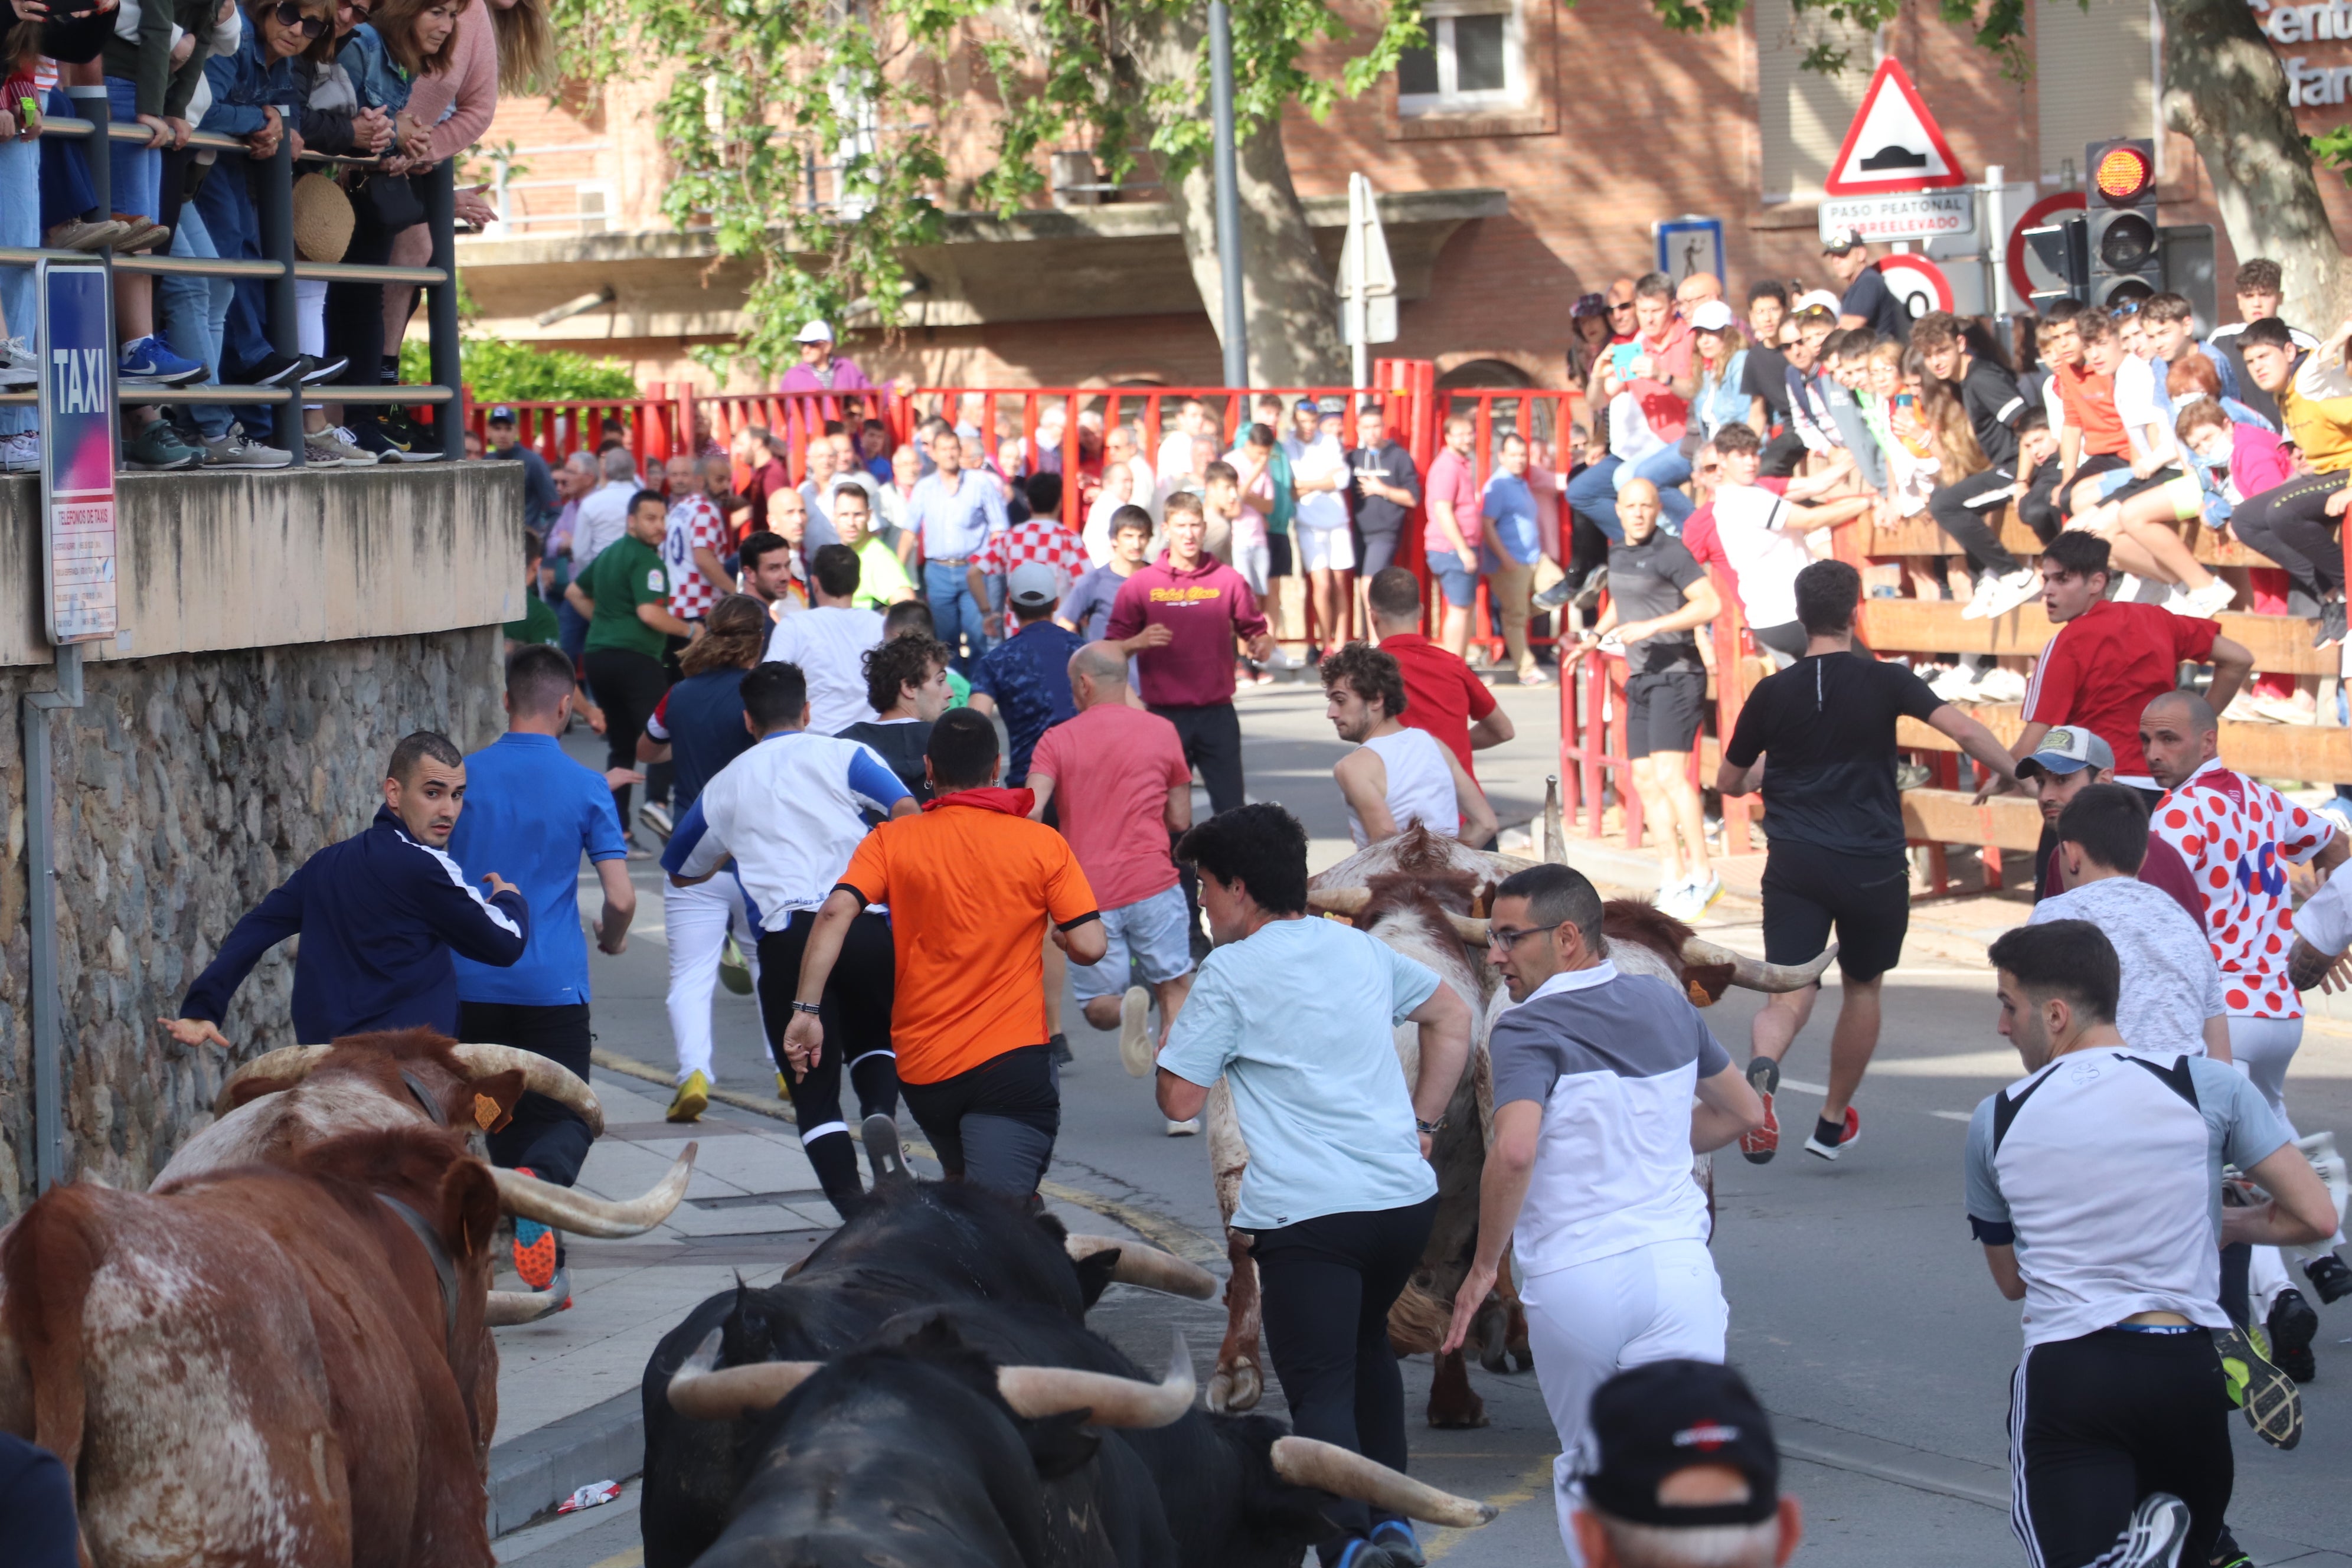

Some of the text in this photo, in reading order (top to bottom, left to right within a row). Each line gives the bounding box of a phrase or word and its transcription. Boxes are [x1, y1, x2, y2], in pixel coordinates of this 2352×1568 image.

[1831, 198, 1963, 218] PASO PEATONAL
[53, 349, 104, 414] TAXI
[58, 508, 108, 525] TELÉFONOS DE TAXIS
